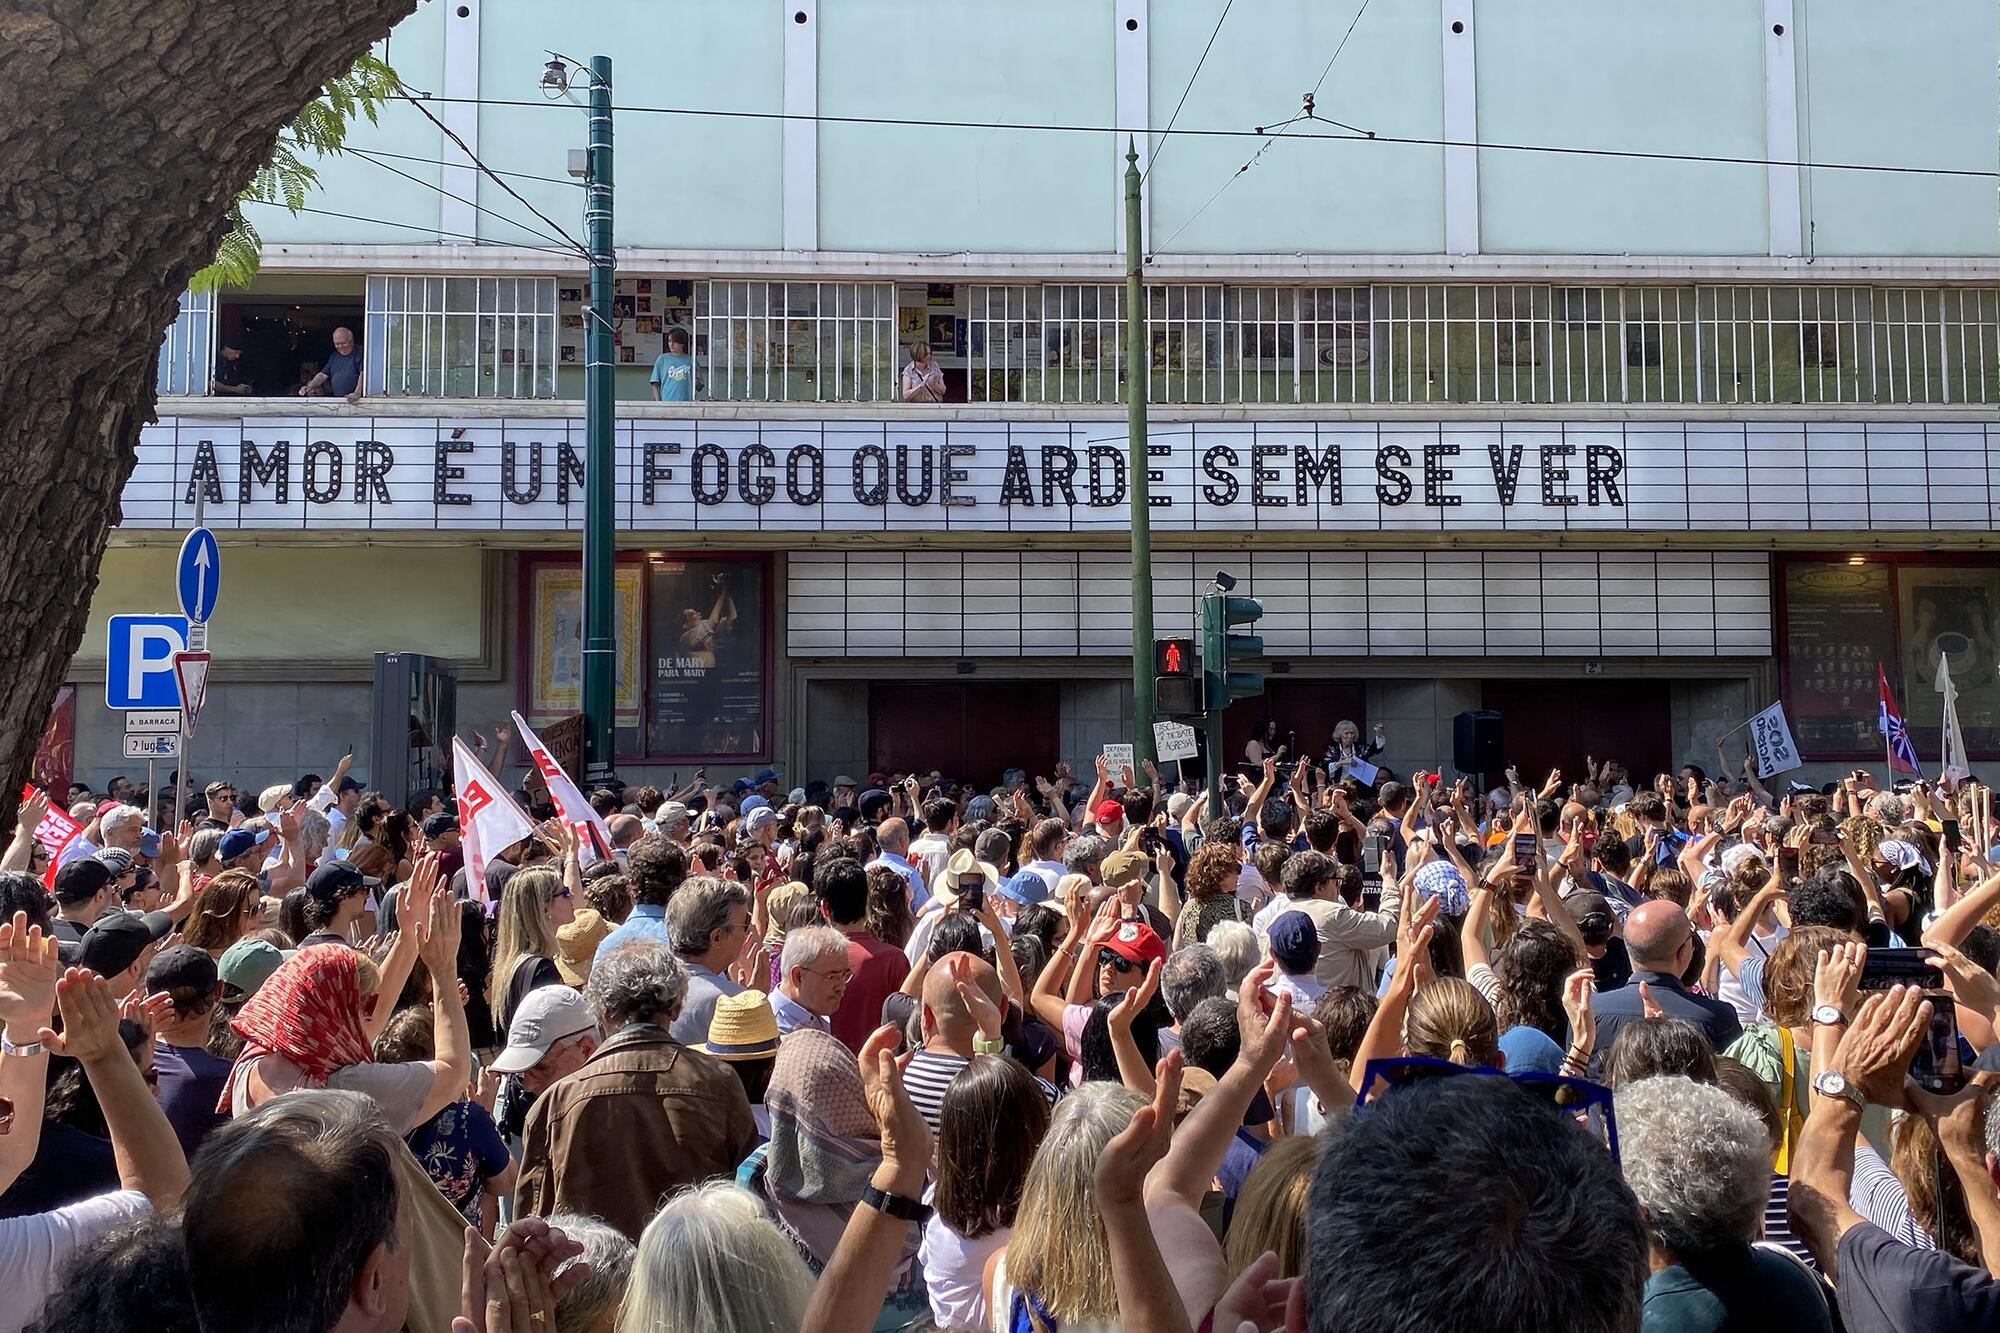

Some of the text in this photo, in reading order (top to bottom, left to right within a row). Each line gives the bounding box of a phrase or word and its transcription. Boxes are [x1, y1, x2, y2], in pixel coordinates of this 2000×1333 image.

[185, 440, 394, 505] AMOR
[434, 428, 474, 506] É
[643, 442, 823, 507] FOGO
[852, 444, 976, 507] QUE
[999, 444, 1173, 507] ARDE
[1202, 444, 1342, 507] SEM
[1375, 444, 1462, 507] SE
[1487, 444, 1625, 507] VER
[128, 625, 184, 699] P
[658, 657, 705, 669] DE MARY
[658, 669, 706, 678] PARA MARY
[132, 740, 139, 751] 2
